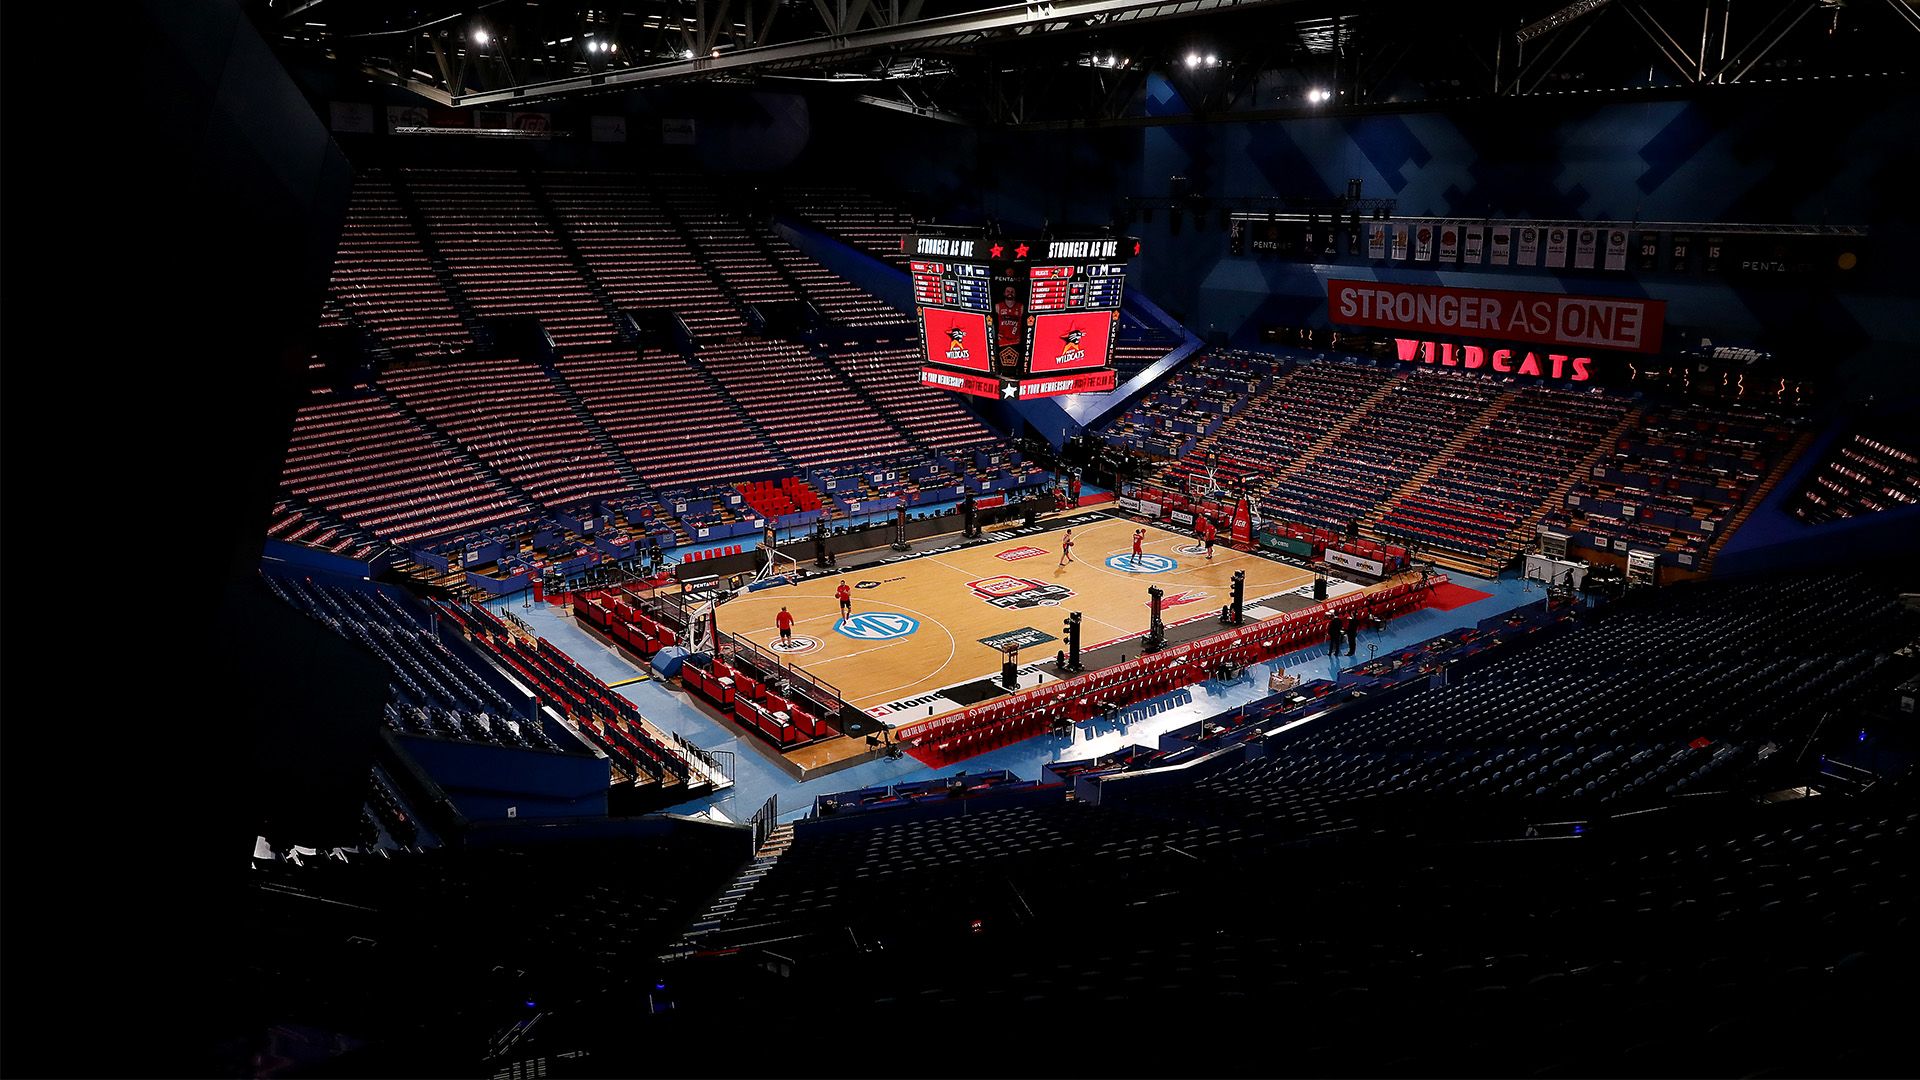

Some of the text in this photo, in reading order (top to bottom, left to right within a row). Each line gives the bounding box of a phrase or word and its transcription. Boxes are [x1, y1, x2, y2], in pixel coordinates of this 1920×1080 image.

[917, 238, 975, 257] STRONGER AS ONE
[1048, 241, 1118, 258] STRONGER AS ONE
[1641, 245, 1656, 256] 30
[1674, 246, 1686, 257] 21
[1709, 247, 1721, 258] 15
[1340, 287, 1639, 343] STRONGER AS ONE
[945, 350, 970, 359] WILDCATS
[1055, 349, 1085, 364] WILDCATS
[1395, 338, 1592, 381] WILDCATS
[1713, 346, 1762, 365] Thrifty
[1040, 380, 1074, 394] MEMBERSHIP?
[693, 580, 719, 589] PENTANET
[992, 586, 1065, 607] FINALS
[847, 616, 909, 636] MG
